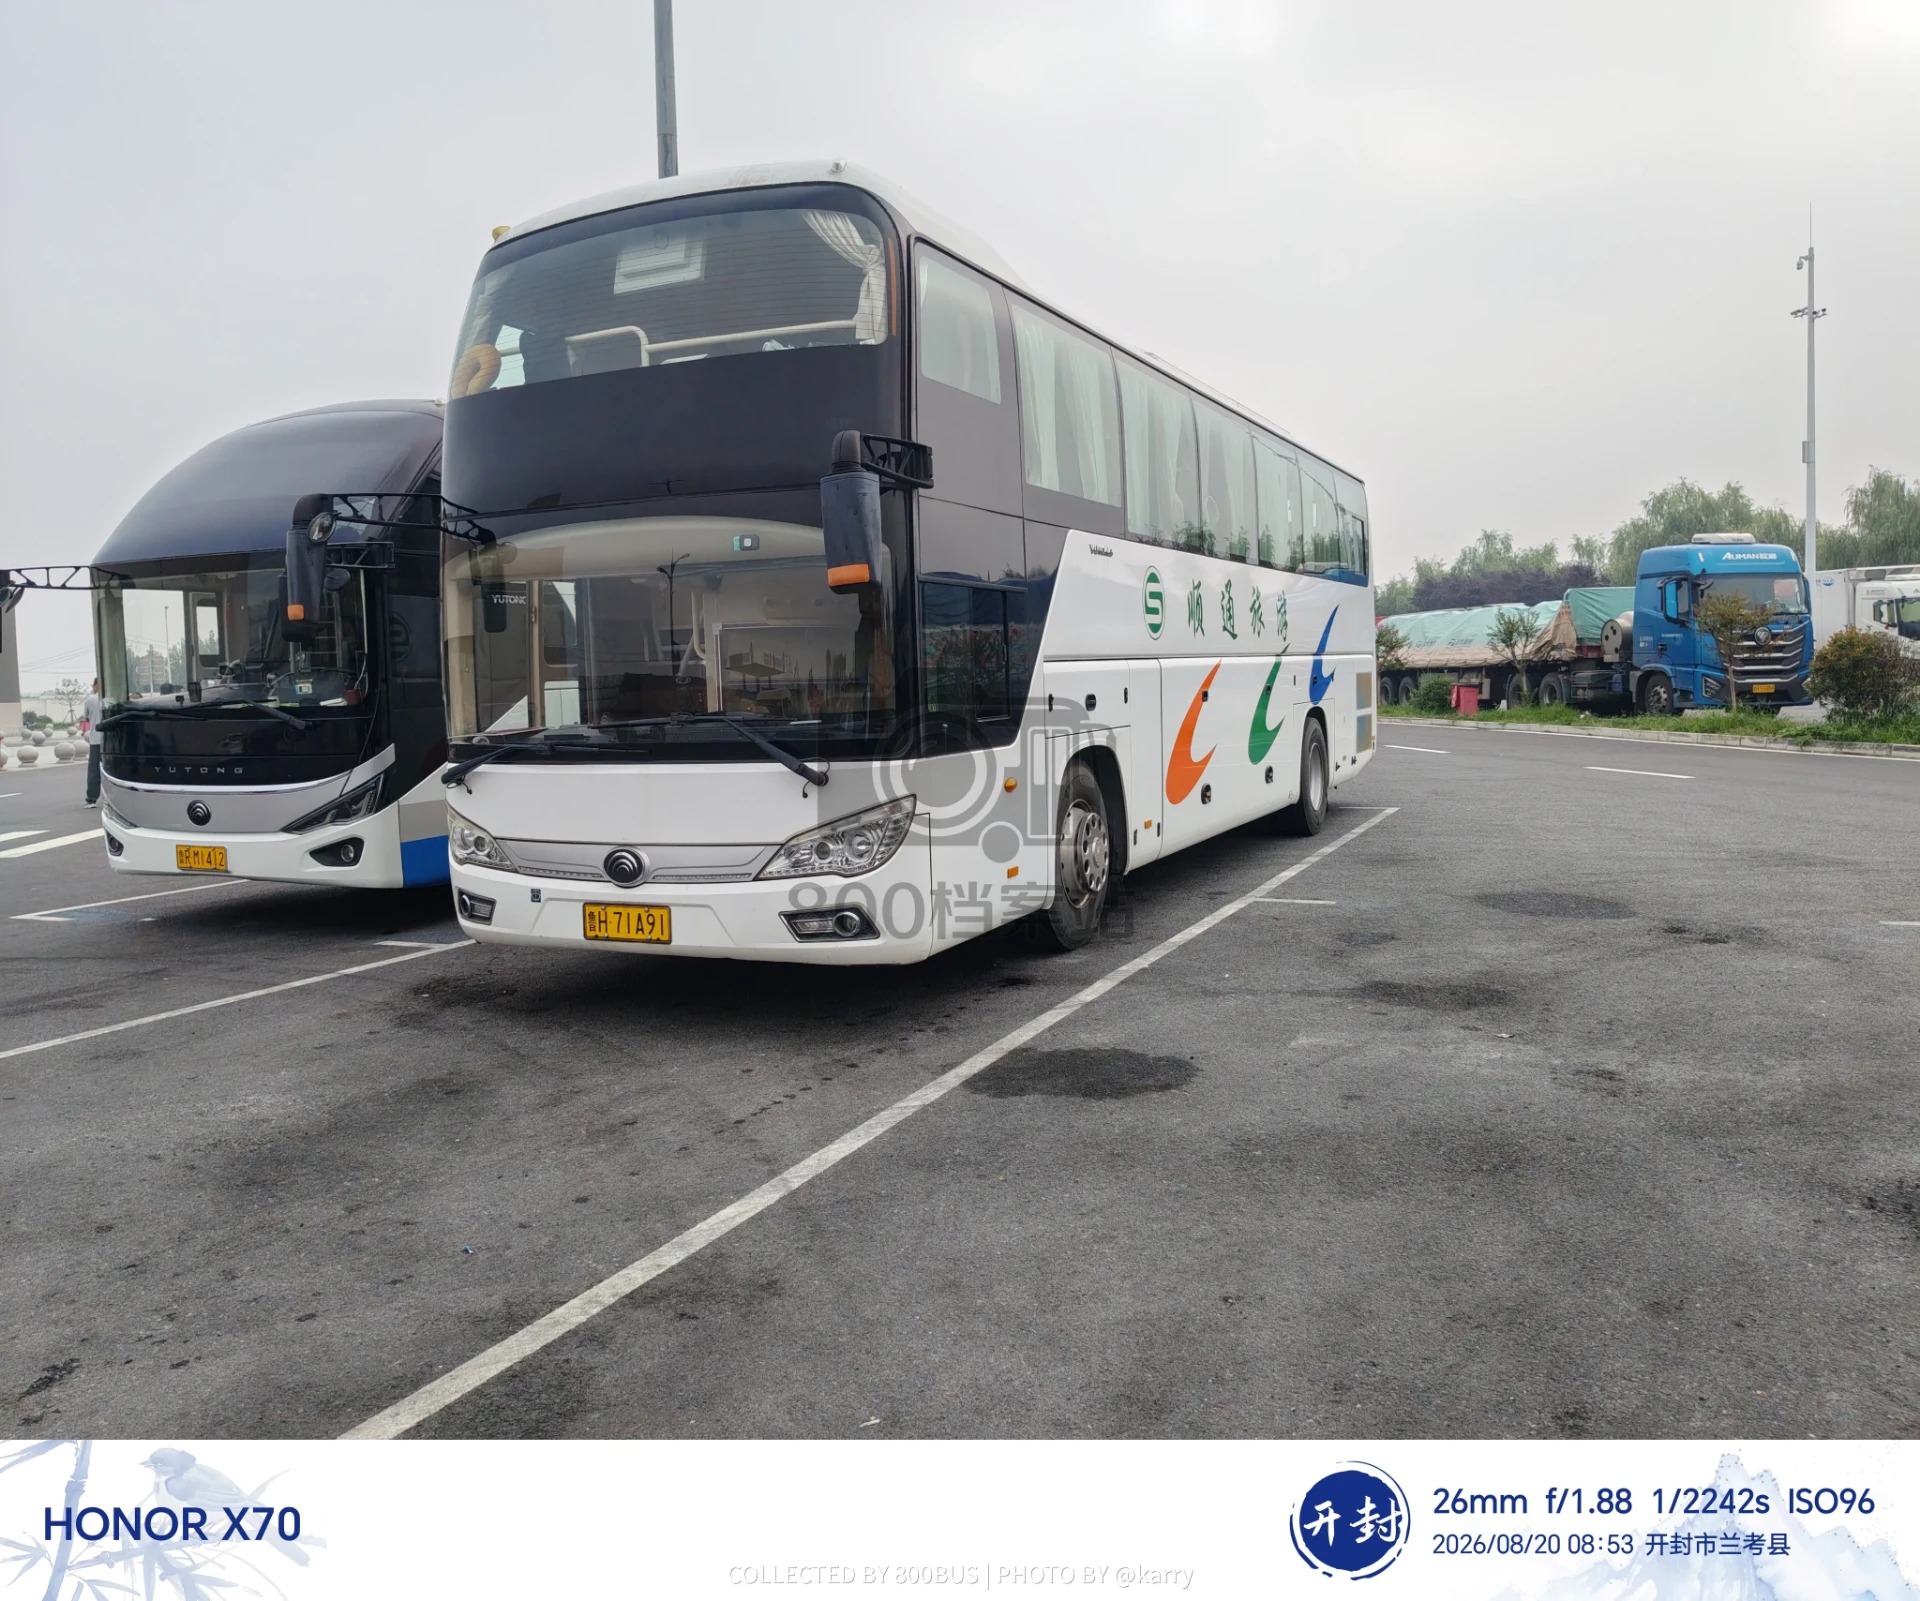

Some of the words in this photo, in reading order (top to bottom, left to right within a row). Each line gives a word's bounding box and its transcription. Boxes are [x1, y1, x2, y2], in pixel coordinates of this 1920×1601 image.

[1187, 578, 1289, 642] 顺通旅游
[155, 766, 244, 774] YUTONG
